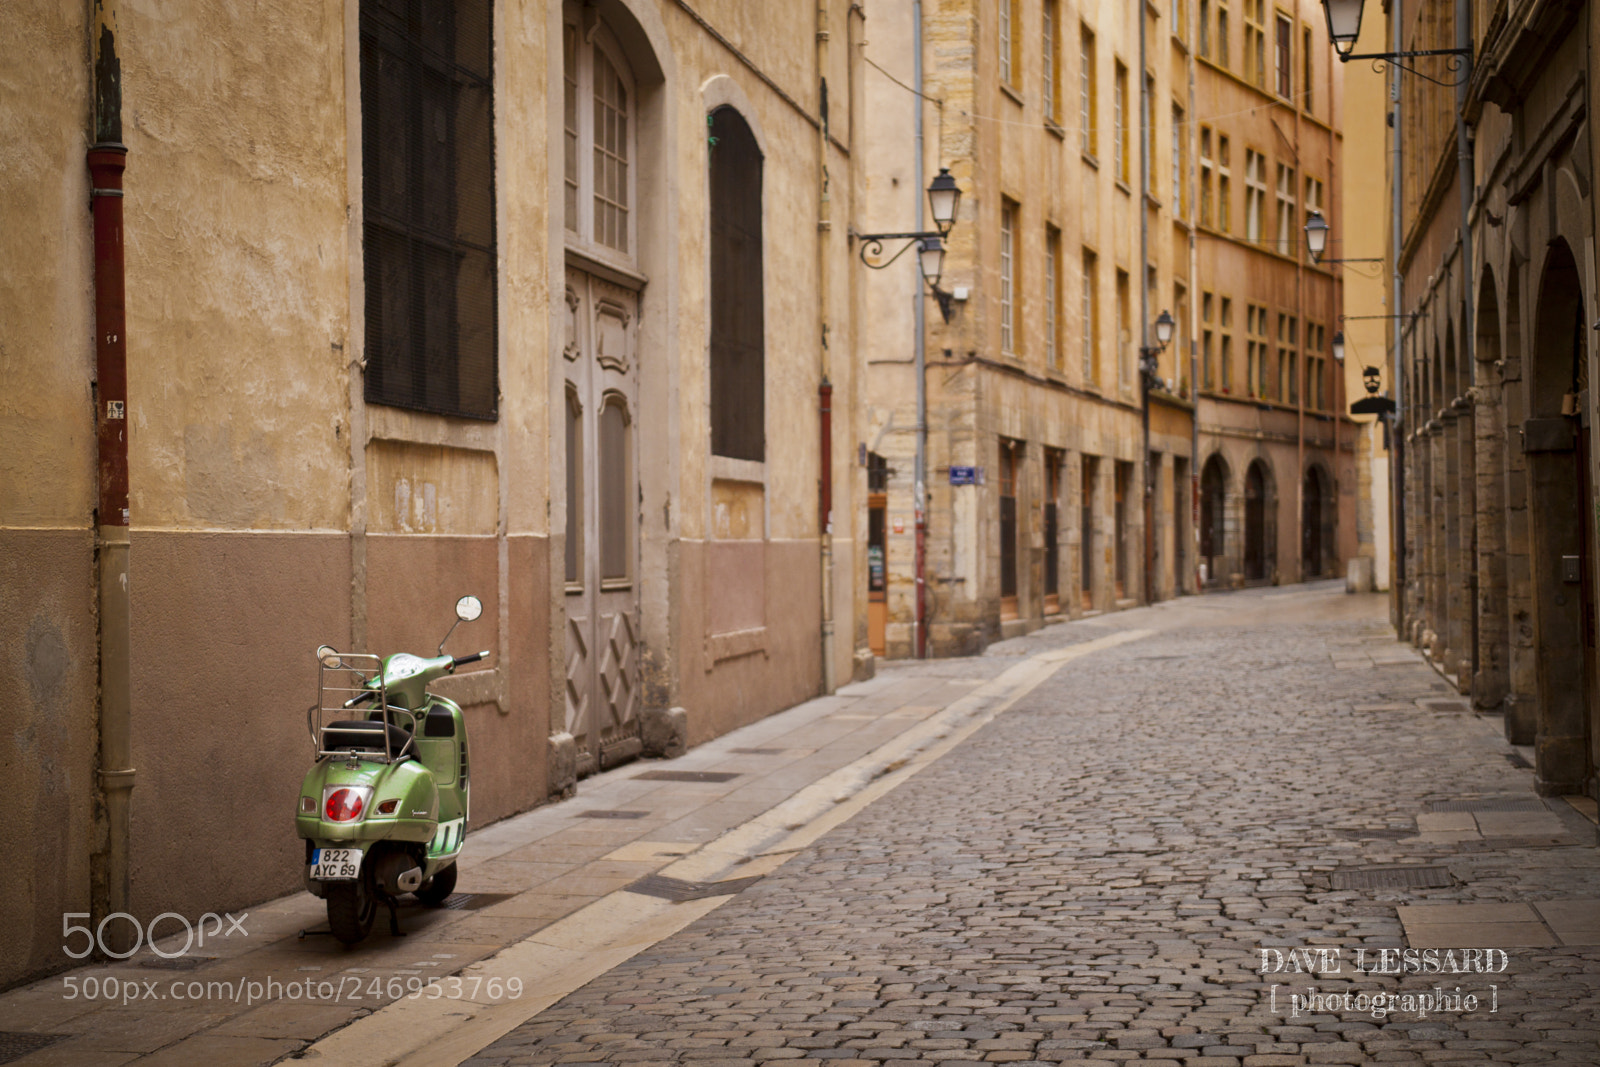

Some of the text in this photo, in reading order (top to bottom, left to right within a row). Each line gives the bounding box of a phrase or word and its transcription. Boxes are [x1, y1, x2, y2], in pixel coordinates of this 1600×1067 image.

[323, 850, 350, 862] 822
[314, 864, 356, 876] AYC 69
